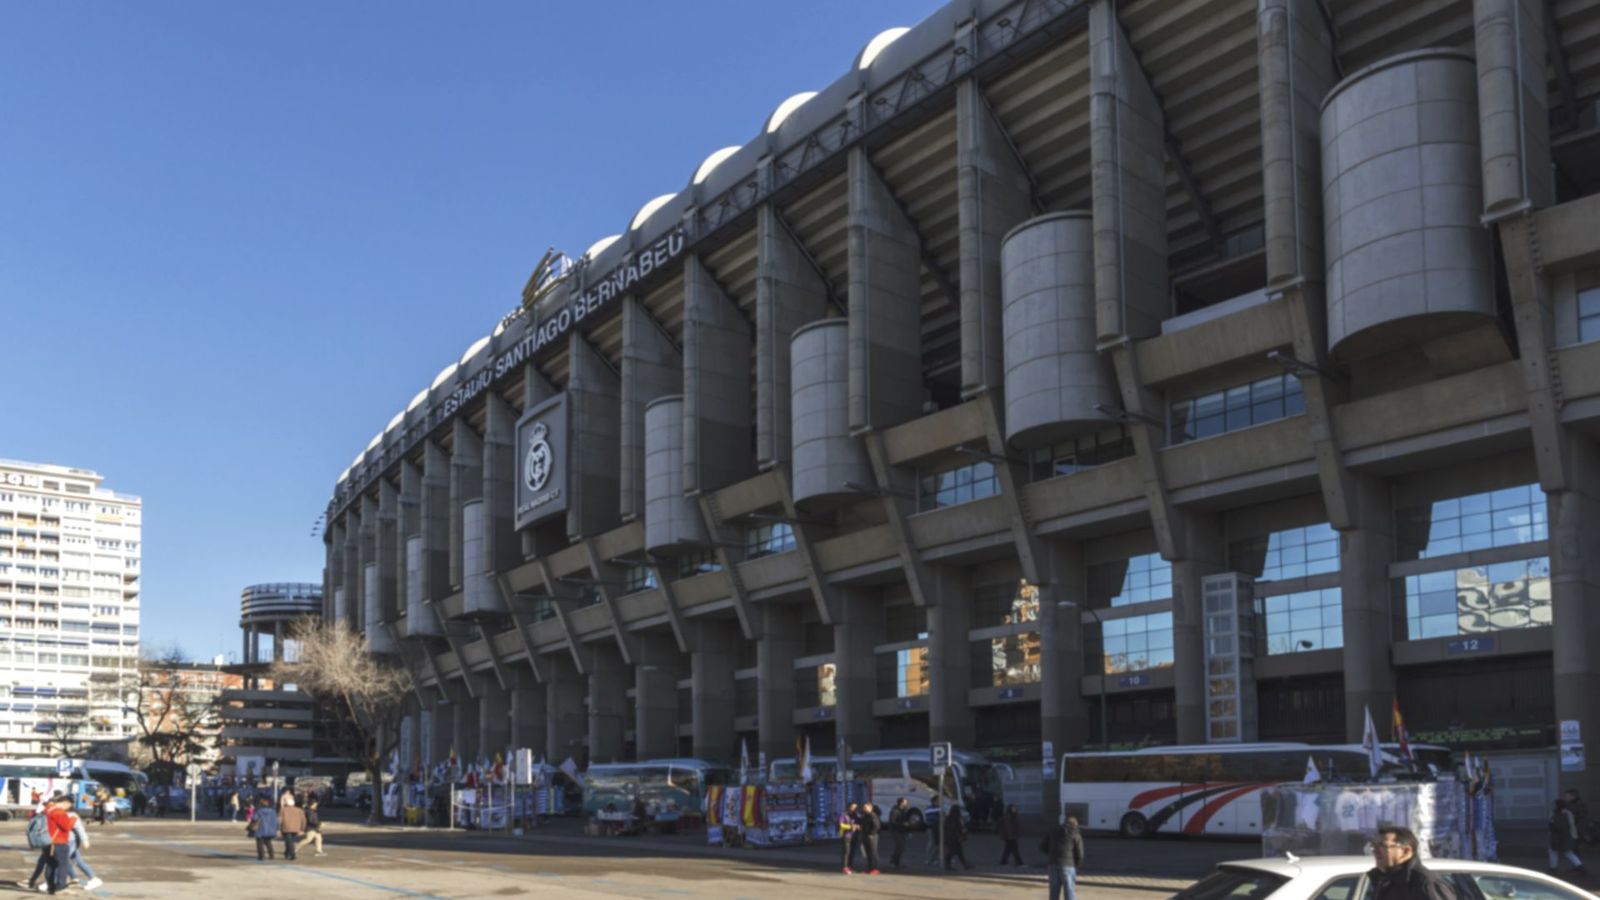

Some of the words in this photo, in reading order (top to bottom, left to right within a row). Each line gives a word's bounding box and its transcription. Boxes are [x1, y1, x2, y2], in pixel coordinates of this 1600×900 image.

[495, 309, 570, 378] SANTIAGO
[1463, 640, 1478, 650] 12
[1129, 676, 1140, 684] 10
[933, 746, 945, 764] P
[60, 761, 70, 770] P
